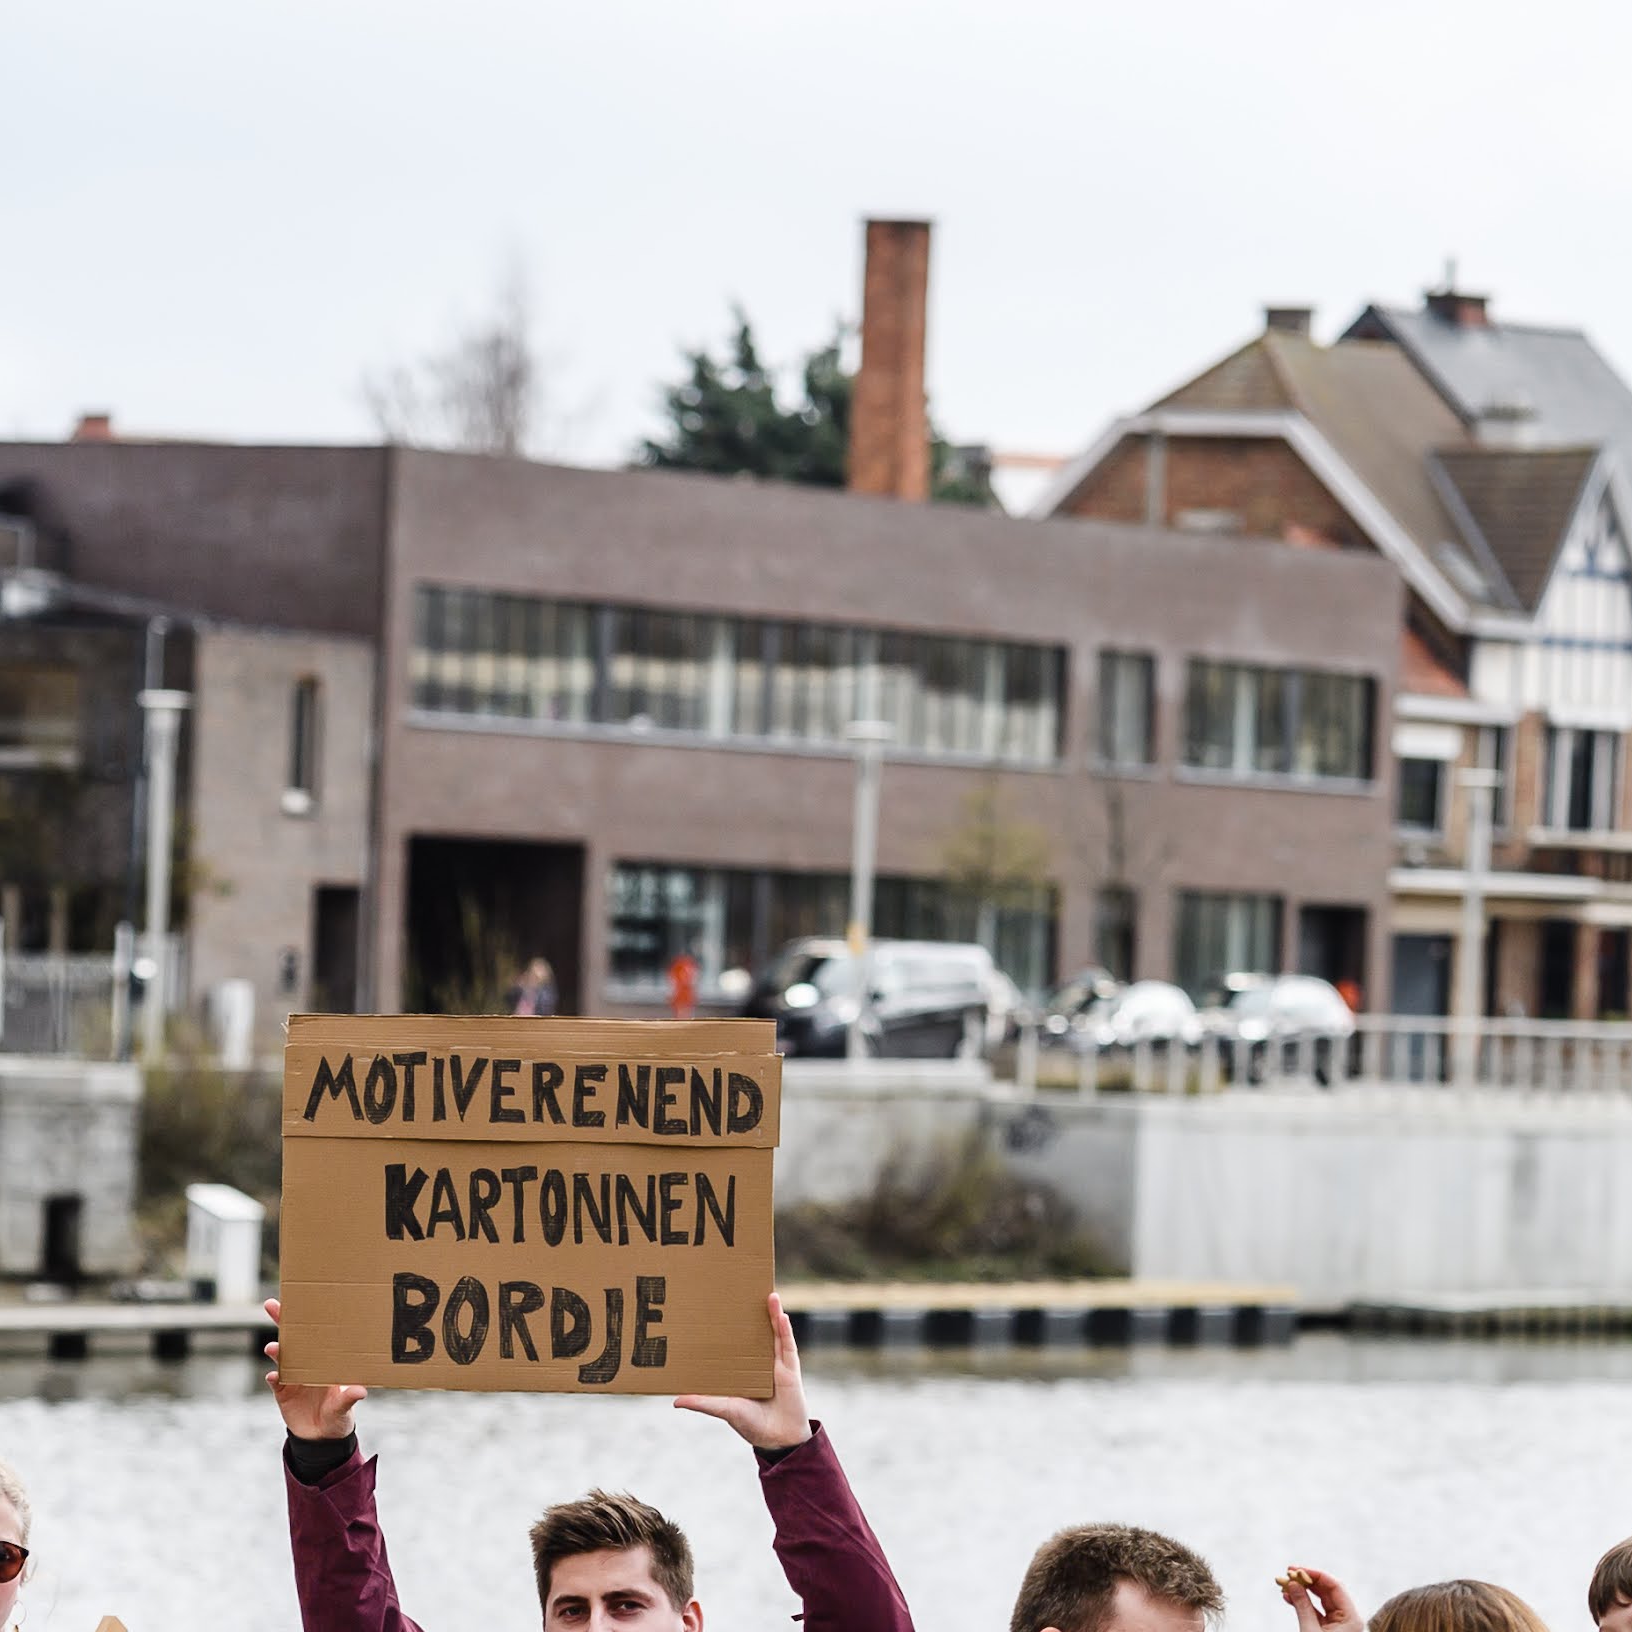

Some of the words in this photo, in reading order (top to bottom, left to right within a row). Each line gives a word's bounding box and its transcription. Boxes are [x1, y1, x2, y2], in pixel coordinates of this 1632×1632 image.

[302, 1051, 764, 1137] MOTIVERENEND
[385, 1163, 736, 1247] KARTONNEN
[391, 1272, 667, 1384] BORDJE
